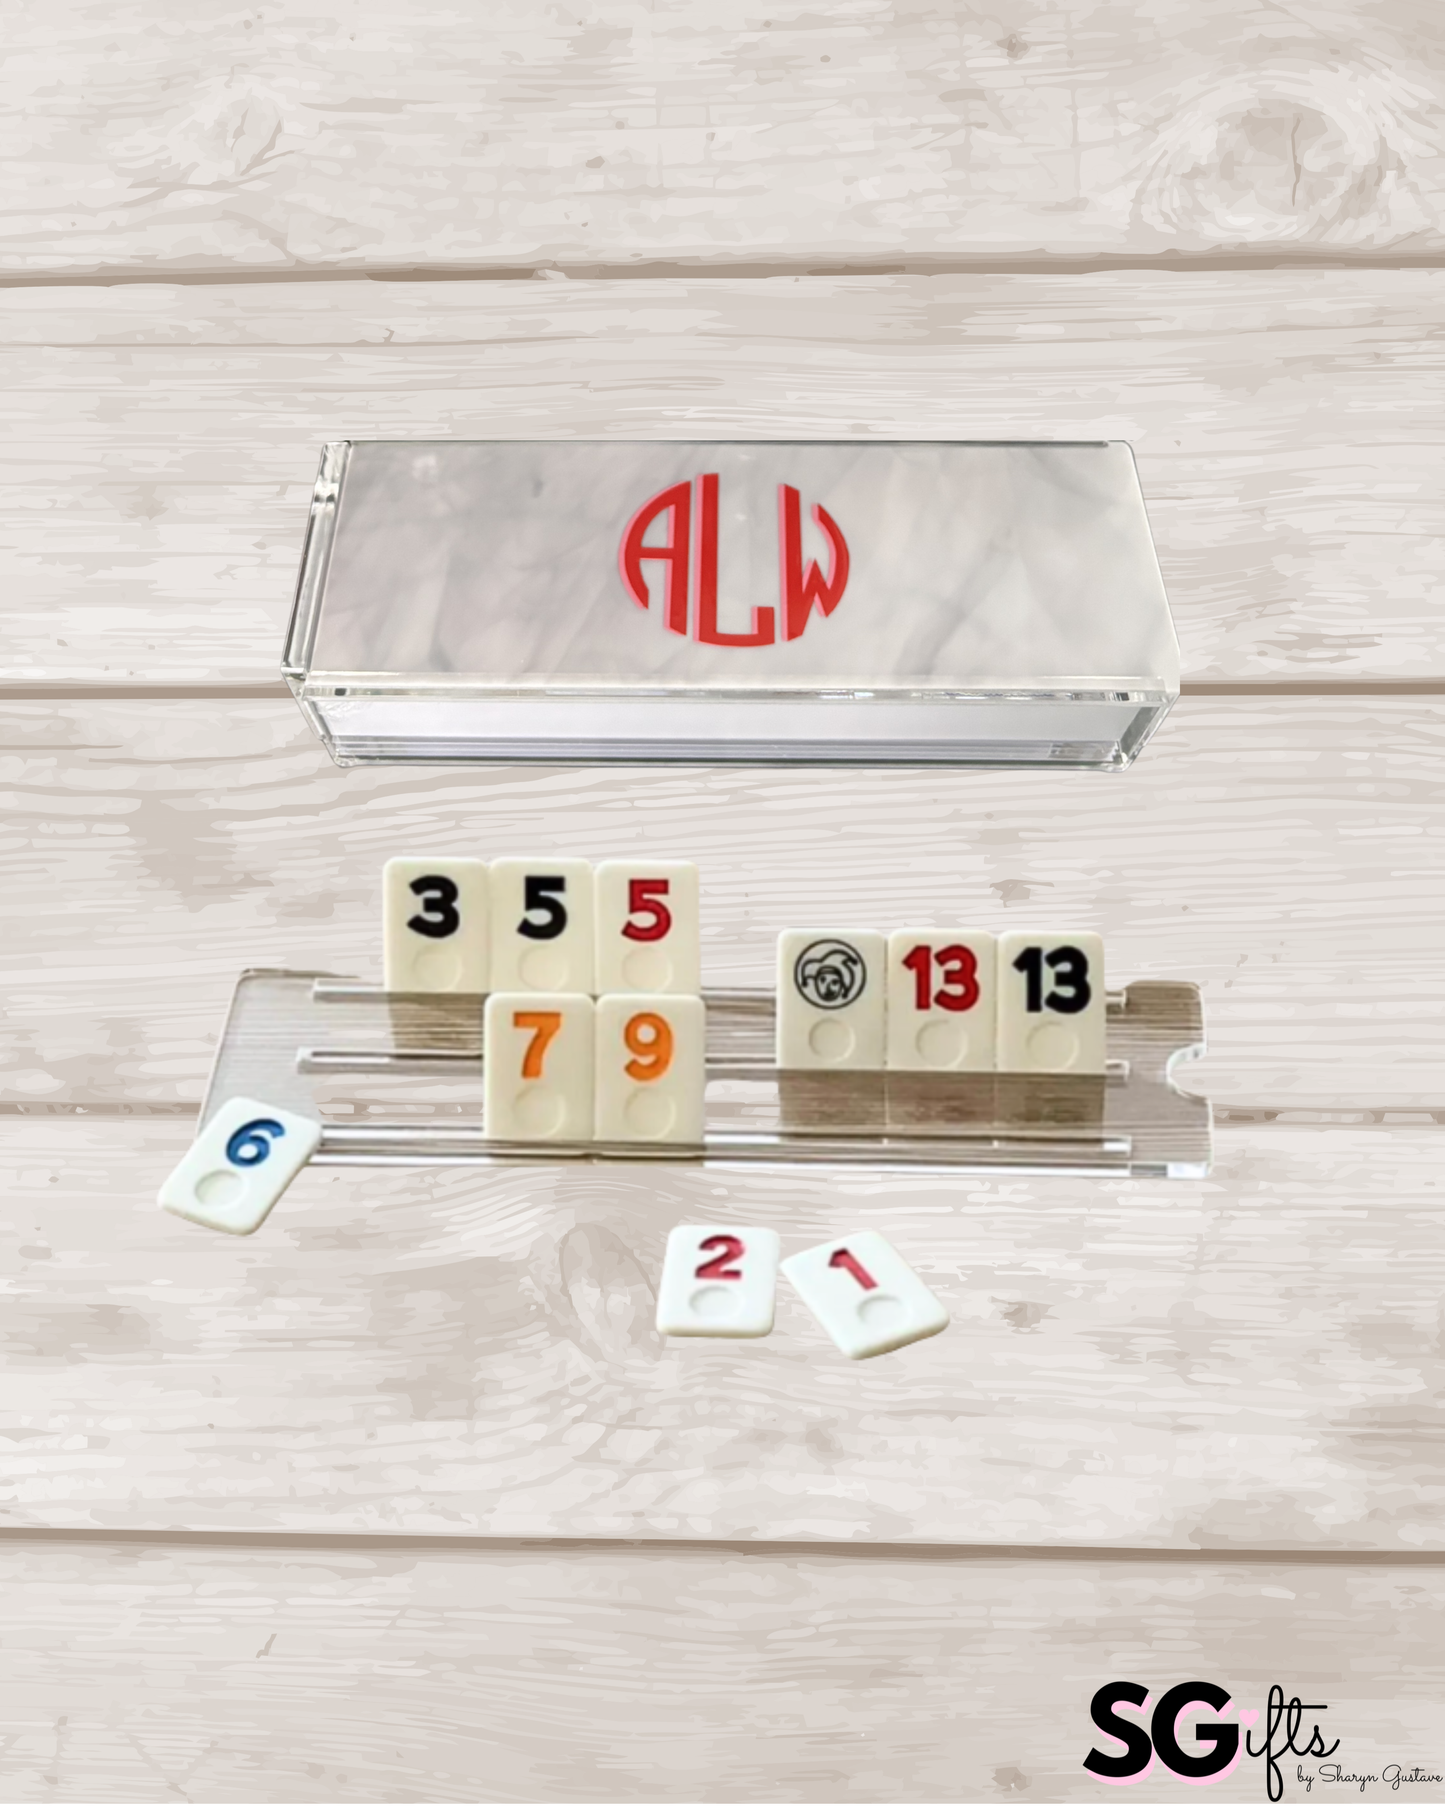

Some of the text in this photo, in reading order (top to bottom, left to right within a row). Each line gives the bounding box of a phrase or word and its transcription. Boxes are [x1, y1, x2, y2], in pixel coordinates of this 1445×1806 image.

[617, 472, 851, 647] ALW
[406, 875, 460, 938] 3
[516, 875, 568, 940] 5
[621, 879, 672, 942] 5
[902, 944, 980, 1011] 13
[1012, 946, 1092, 1014] 13
[512, 1012, 562, 1078] 7
[624, 1012, 674, 1082] 9
[225, 1118, 285, 1167] 6
[694, 1234, 745, 1280] 2
[828, 1247, 878, 1291] 1
